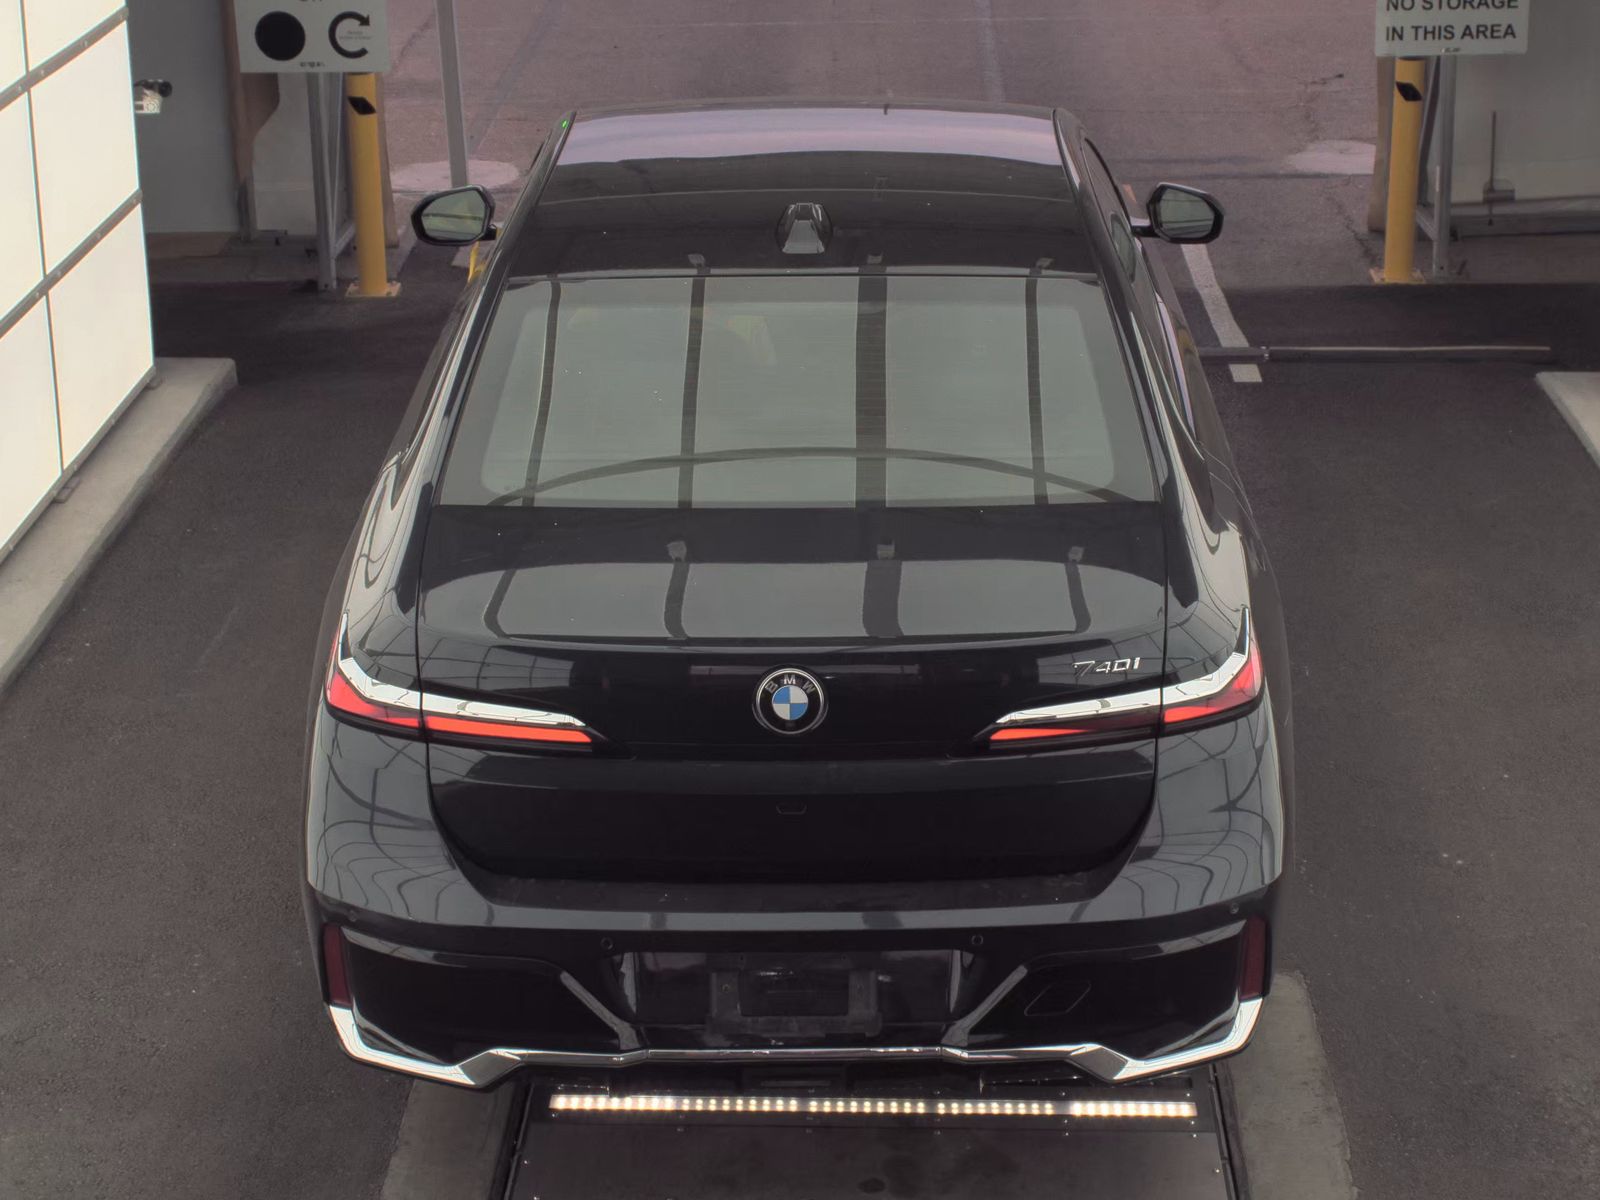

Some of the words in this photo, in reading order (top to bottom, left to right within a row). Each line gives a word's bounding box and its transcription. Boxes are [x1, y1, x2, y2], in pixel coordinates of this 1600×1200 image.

[1386, 0, 1415, 11] NO
[1421, 0, 1518, 11] STORAGE
[1386, 26, 1404, 41] IN
[1411, 25, 1455, 41] THIS
[1460, 23, 1517, 40] AREA
[764, 674, 816, 694] BMW
